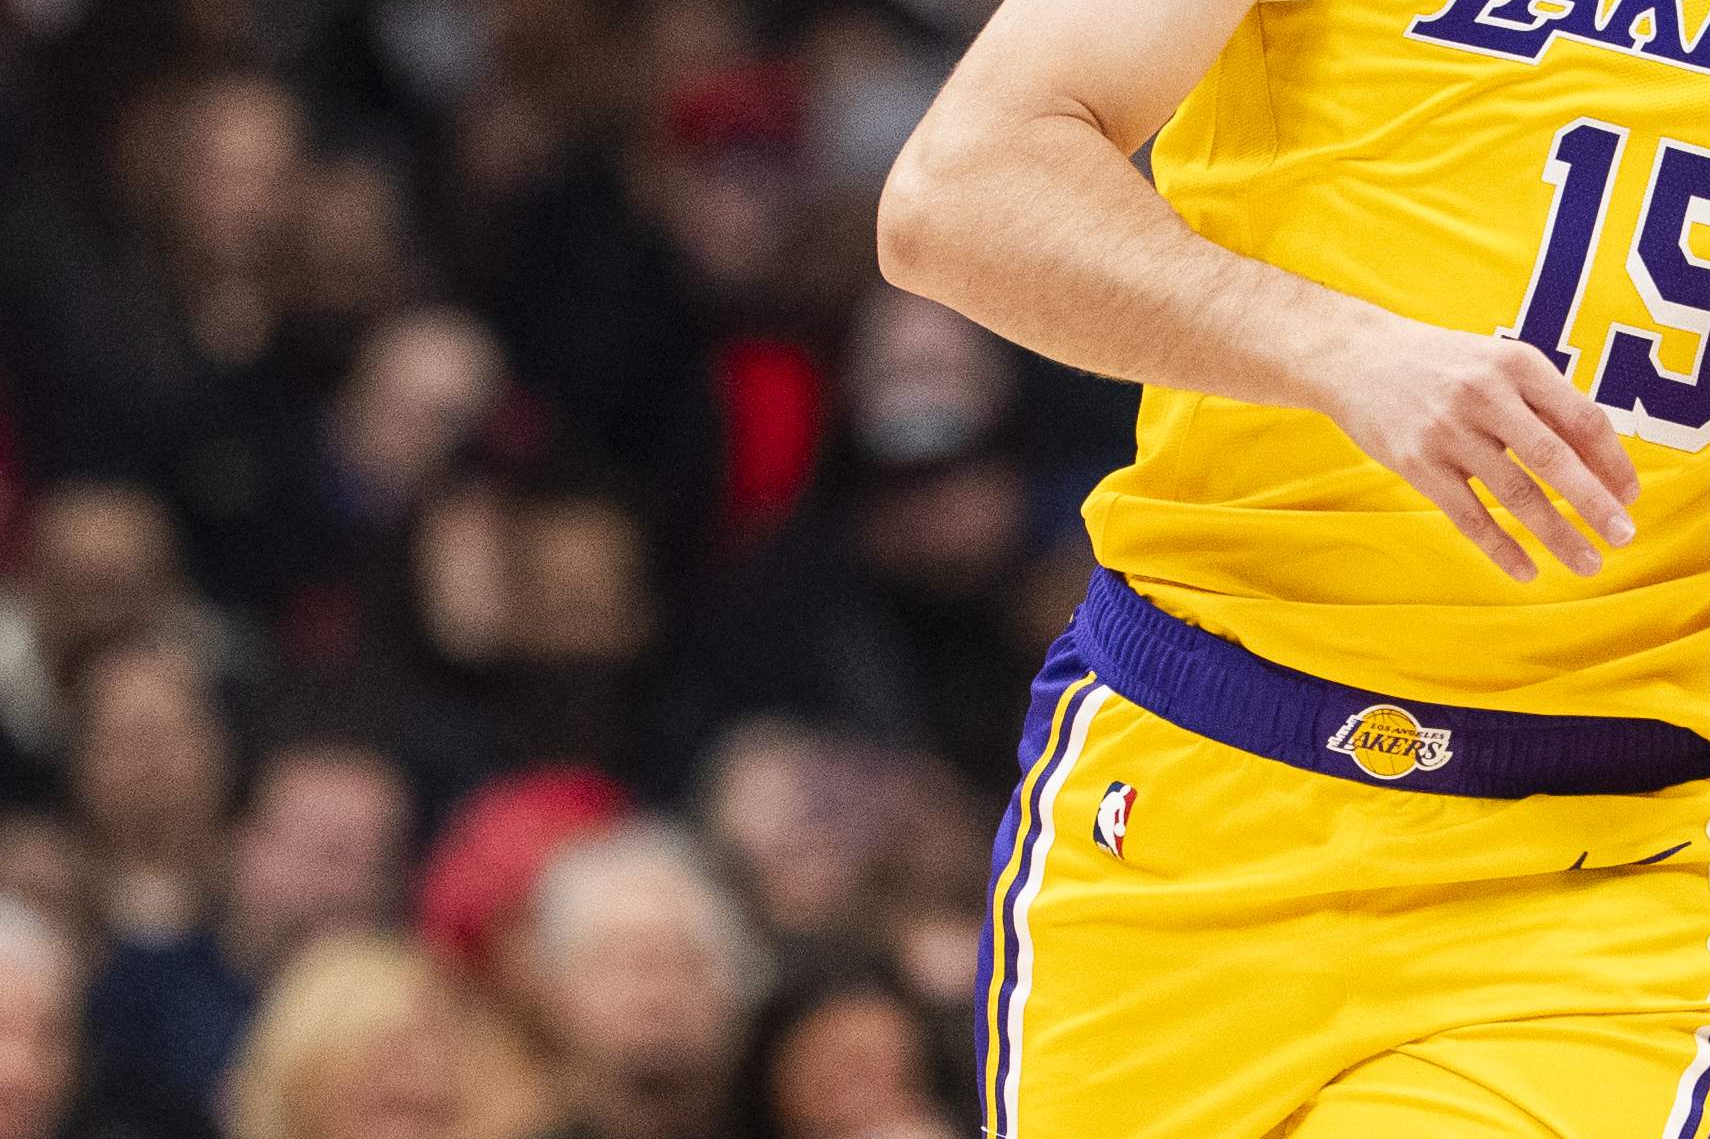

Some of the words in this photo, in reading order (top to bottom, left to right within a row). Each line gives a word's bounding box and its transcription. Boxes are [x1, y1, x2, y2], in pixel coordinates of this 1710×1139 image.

[1335, 718, 1446, 768] LAKERS
[1370, 722, 1391, 732] LOS
[1392, 724, 1446, 741] ANGELES
